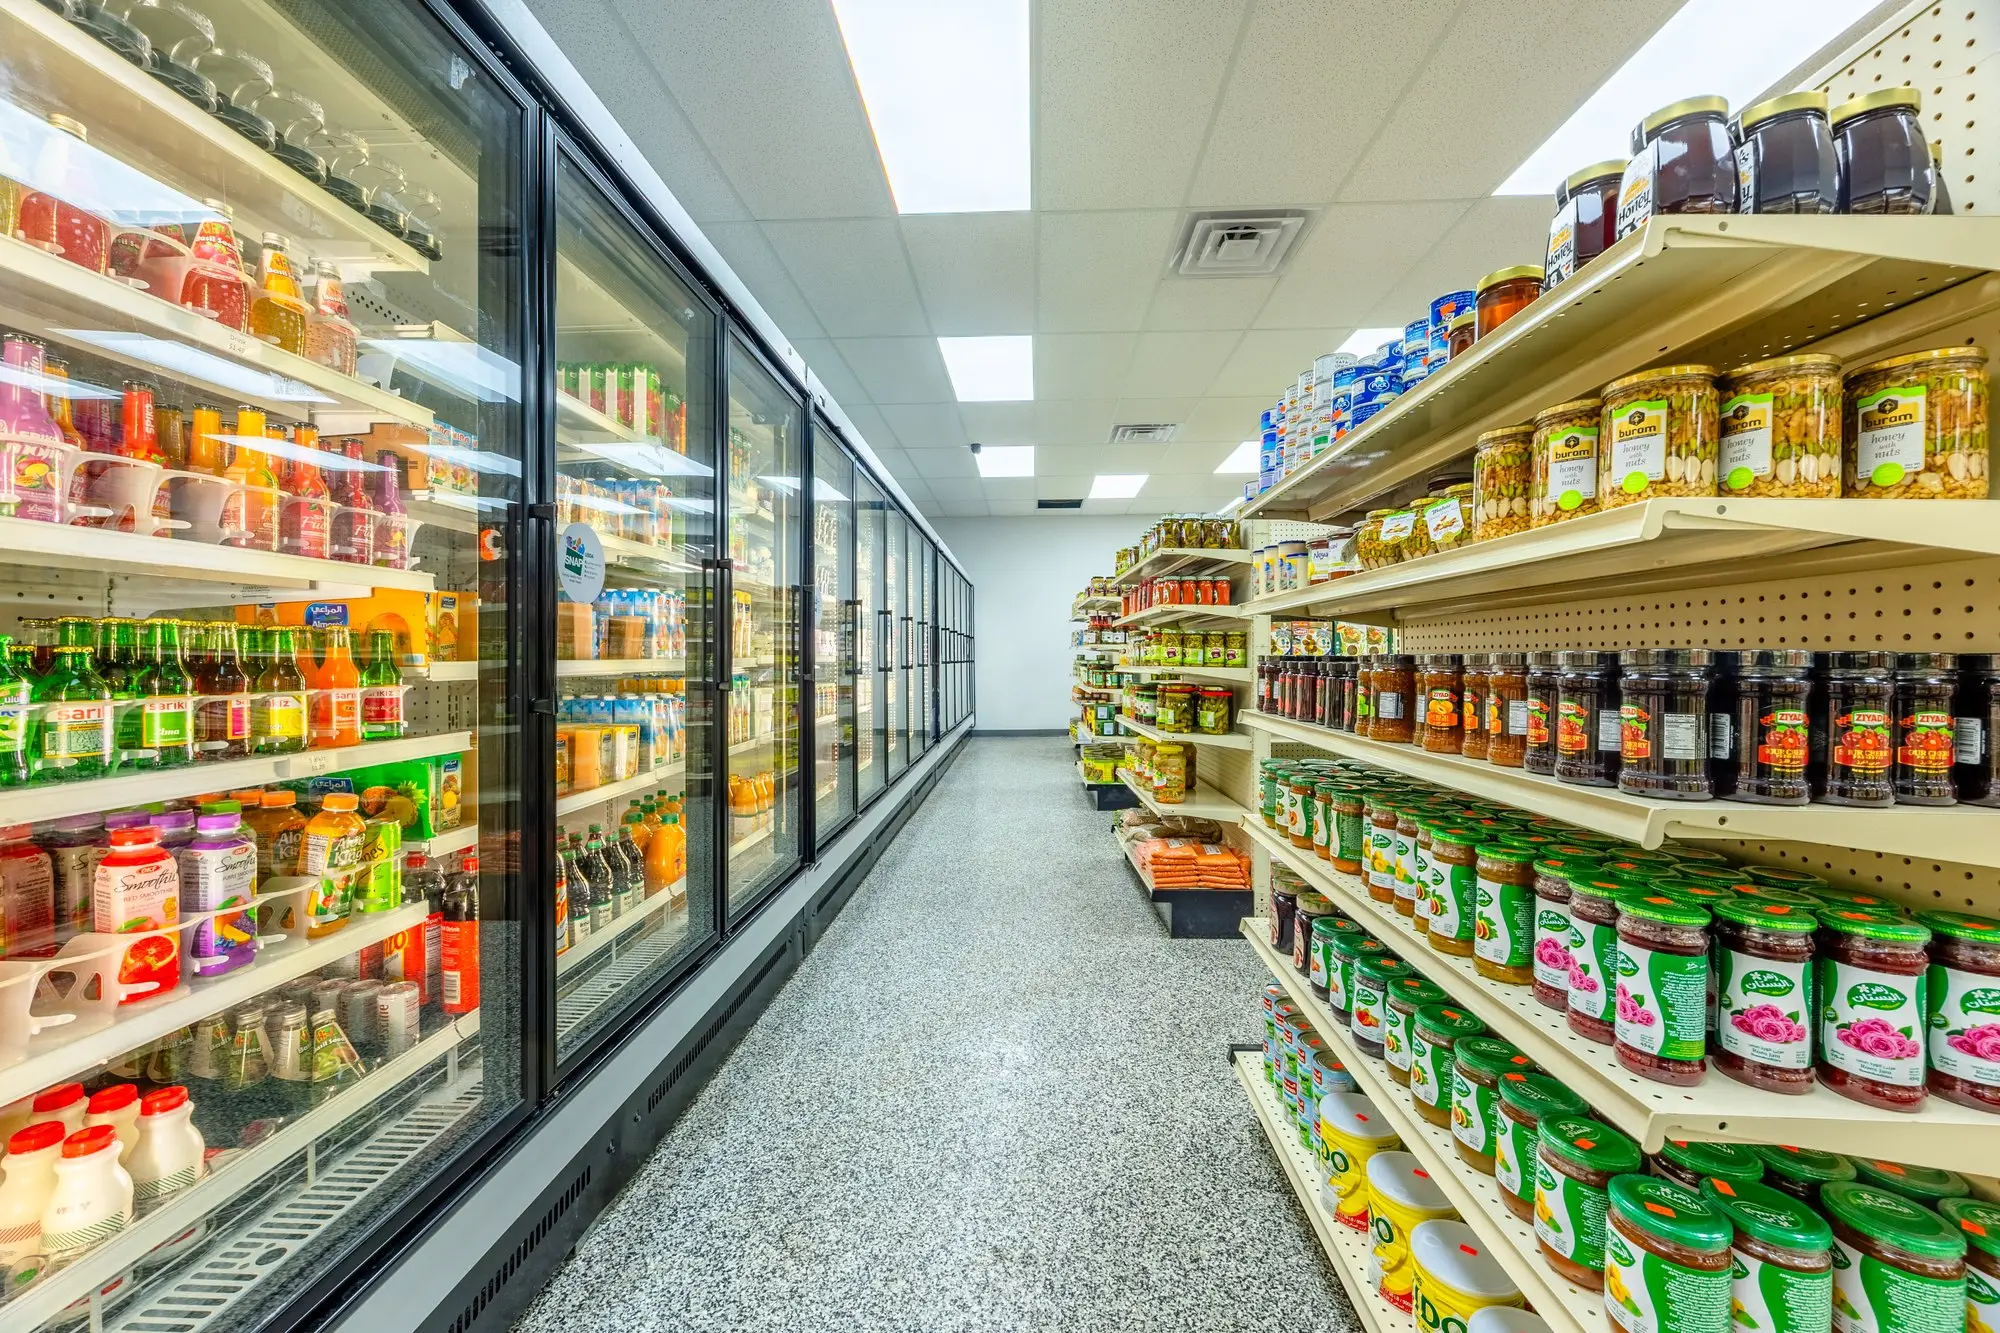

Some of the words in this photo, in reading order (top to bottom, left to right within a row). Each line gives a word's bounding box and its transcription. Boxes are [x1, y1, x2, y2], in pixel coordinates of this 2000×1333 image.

[1618, 189, 1651, 225] Honey
[1547, 241, 1573, 269] Honey
[146, 403, 155, 434] SPIKO
[1866, 412, 1912, 429] buram
[1619, 425, 1657, 438] buram
[1726, 436, 1755, 449] honey
[1871, 431, 1906, 445] honey
[1622, 443, 1651, 454] honey
[1874, 447, 1901, 459] nuts
[1555, 449, 1590, 460] buram
[1728, 452, 1751, 464] nuts
[1625, 458, 1646, 467] nuts
[1559, 464, 1585, 474] honey
[1561, 478, 1581, 486] nuts
[565, 555, 583, 567] SNAP
[311, 605, 342, 615] المراعي
[1779, 713, 1802, 721] ZIYAD
[1855, 714, 1883, 722] ZIYAD
[1919, 714, 1946, 723] ZIYAD
[315, 780, 346, 790] المراعي
[140, 887, 173, 900] SMOOTHIE
[1745, 979, 1793, 989] البستان
[1851, 992, 1905, 1003] البستان
[1321, 1138, 1349, 1173] DO
